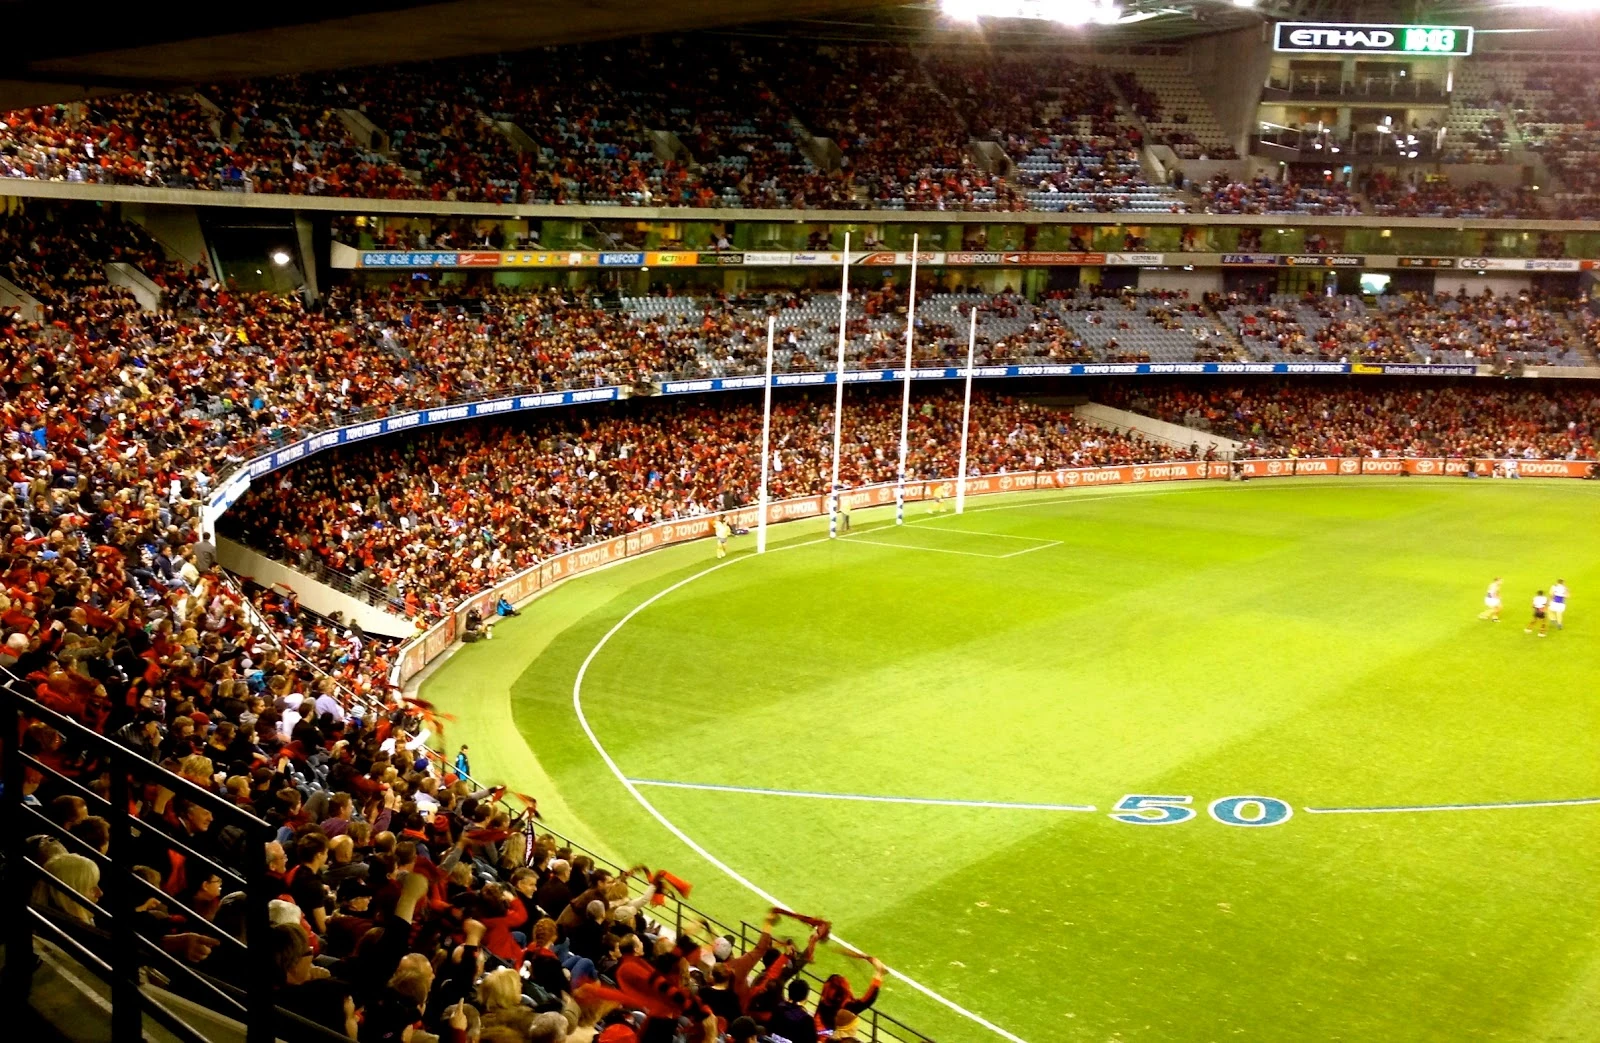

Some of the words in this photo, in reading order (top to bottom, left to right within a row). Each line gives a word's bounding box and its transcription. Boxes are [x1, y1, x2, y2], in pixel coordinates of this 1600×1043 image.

[1290, 29, 1395, 48] ETIHAD
[610, 254, 640, 264] HUFCOR
[947, 254, 1000, 264] MUSHROOM
[1042, 366, 1073, 374] TIRES
[1109, 365, 1139, 373] TIRES
[1243, 364, 1275, 372] TIRES
[1287, 364, 1314, 372] TOYO
[1313, 364, 1345, 372] TIRES
[777, 376, 801, 384] TOYO
[800, 374, 826, 383] TIRES
[858, 372, 883, 380] TIRES
[666, 383, 689, 392] TOYO
[688, 381, 713, 390] TIRES
[721, 379, 744, 388] TOYO
[520, 397, 541, 407] TOYO
[540, 394, 565, 405] TIRES
[572, 391, 593, 402] TOYO
[592, 389, 615, 400] TIRES
[476, 402, 495, 414] TOYO
[493, 400, 514, 411] TIRES
[428, 410, 449, 421] TOYO
[447, 406, 468, 418] TIRES
[387, 418, 404, 430] TOYO
[402, 413, 420, 427] TIRES
[1148, 466, 1188, 477] TOYOTA
[1214, 464, 1255, 475] TOTA
[1521, 463, 1568, 474] TOYOTA
[1083, 471, 1120, 482] TOYOTA
[784, 501, 818, 514] TOYOTA
[675, 520, 709, 536] TOYOTA
[579, 546, 609, 567] TOYOTA
[1107, 793, 1294, 827] 50
